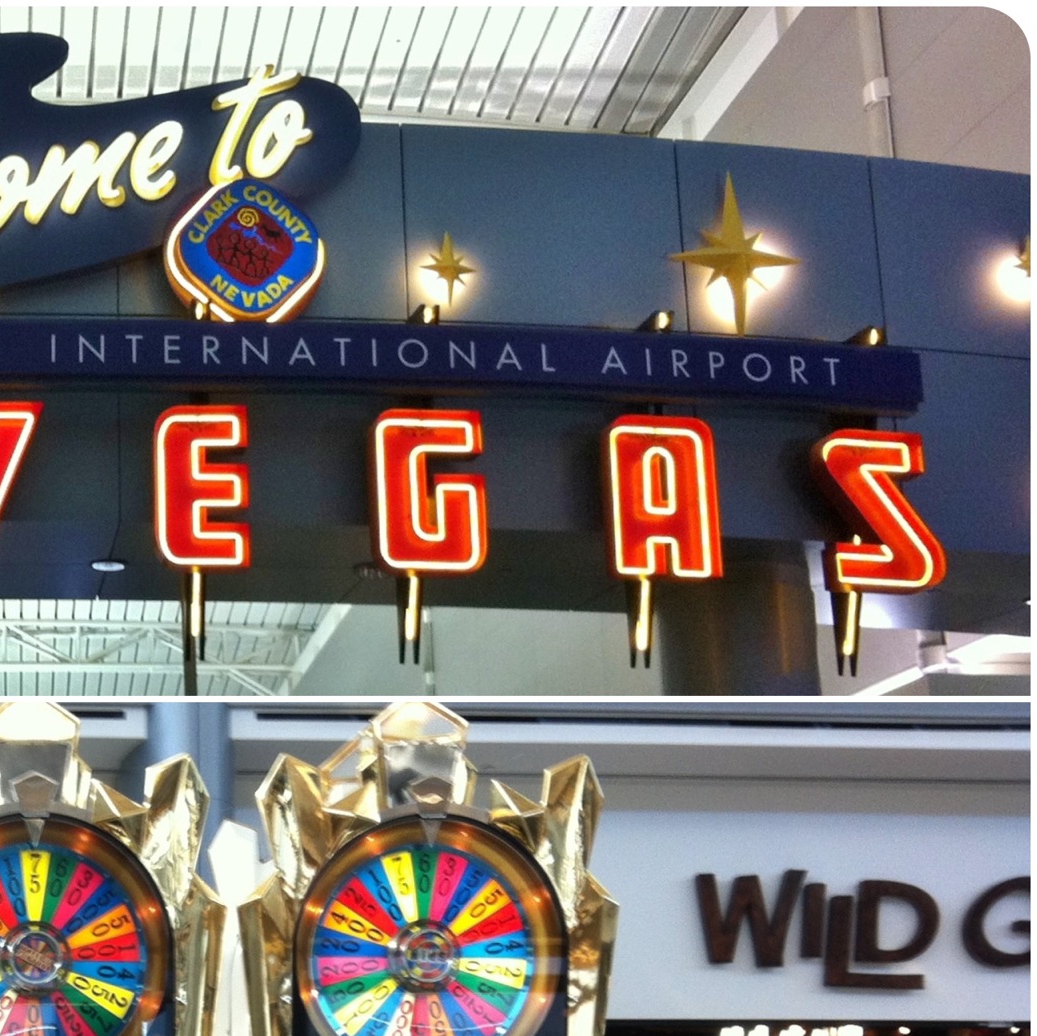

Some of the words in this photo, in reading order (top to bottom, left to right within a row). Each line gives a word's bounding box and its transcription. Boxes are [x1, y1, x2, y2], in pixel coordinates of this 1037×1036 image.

[212, 64, 313, 187] to
[186, 188, 237, 246] CLARK
[242, 184, 313, 248] COUNTY
[210, 272, 294, 312] NEVADA
[49, 334, 556, 374] INTERNATIONAL
[601, 346, 841, 387] AIRPORT
[3, 857, 26, 918] 100
[28, 853, 42, 894] 75
[67, 869, 94, 907] 30
[390, 856, 411, 897] 75
[438, 856, 458, 898] 30
[368, 869, 404, 922] 100
[469, 888, 504, 919] 50
[91, 914, 132, 938] 50
[320, 938, 361, 954] 20
[330, 910, 384, 943] 400
[694, 868, 941, 990] WILD
[77, 944, 137, 960] 100
[484, 939, 525, 956] 40
[96, 964, 136, 979] 40
[320, 959, 380, 979] 200
[72, 975, 129, 1009] 250
[343, 985, 390, 1027] 100
